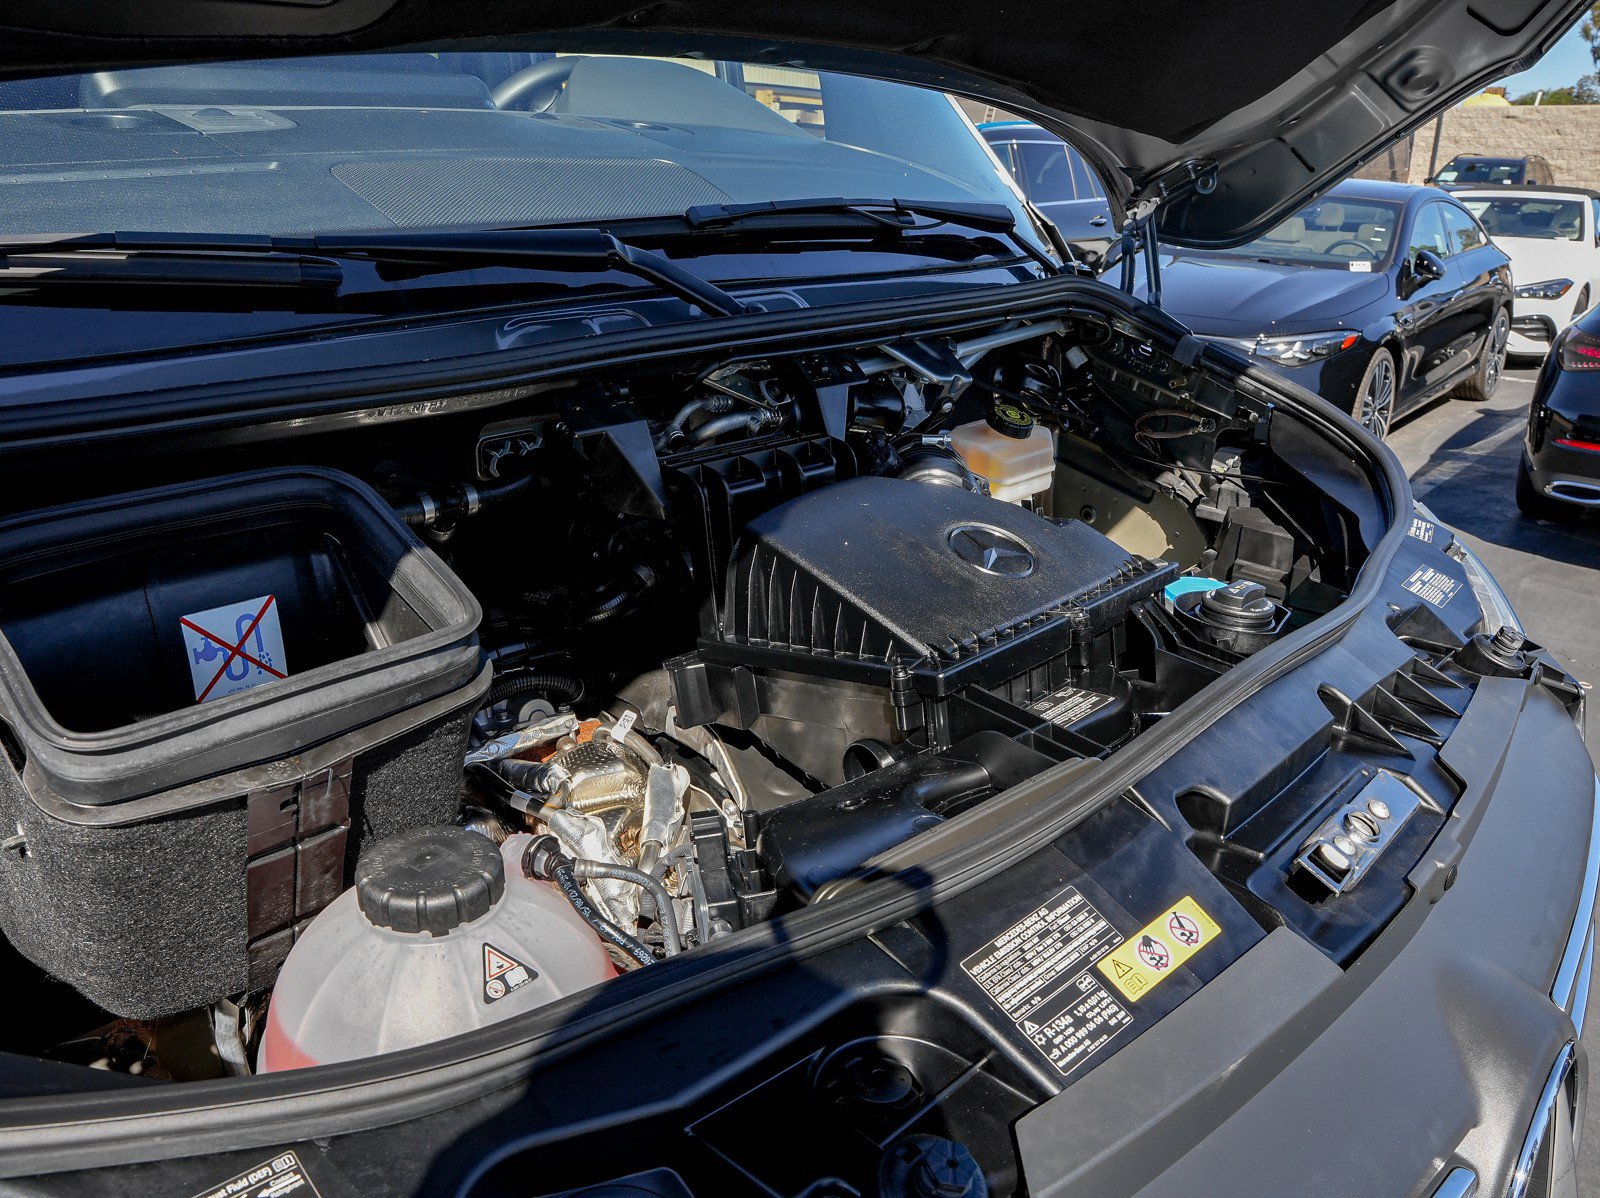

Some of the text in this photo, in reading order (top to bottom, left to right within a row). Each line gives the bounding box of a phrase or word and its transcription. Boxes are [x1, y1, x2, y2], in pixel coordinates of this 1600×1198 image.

[993, 907, 1049, 948] MERCEDES-BENZ AG
[969, 894, 1082, 976] VEHICLE EMISSION CONTROL INFORMATION
[977, 966, 998, 983] Conforms
[991, 974, 1002, 984] EPA
[1096, 990, 1108, 998] kg
[1100, 1003, 1119, 1020] (PAG)
[1043, 1014, 1074, 1038] R-134a
[1085, 1020, 1097, 1031] 06
[1093, 1014, 1104, 1025] 06
[1074, 1027, 1089, 1039] 989
[1063, 1035, 1078, 1048] 000
[1059, 1044, 1068, 1053] A
[225, 1177, 249, 1194] Fluid
[247, 1166, 273, 1184] (DEF)
